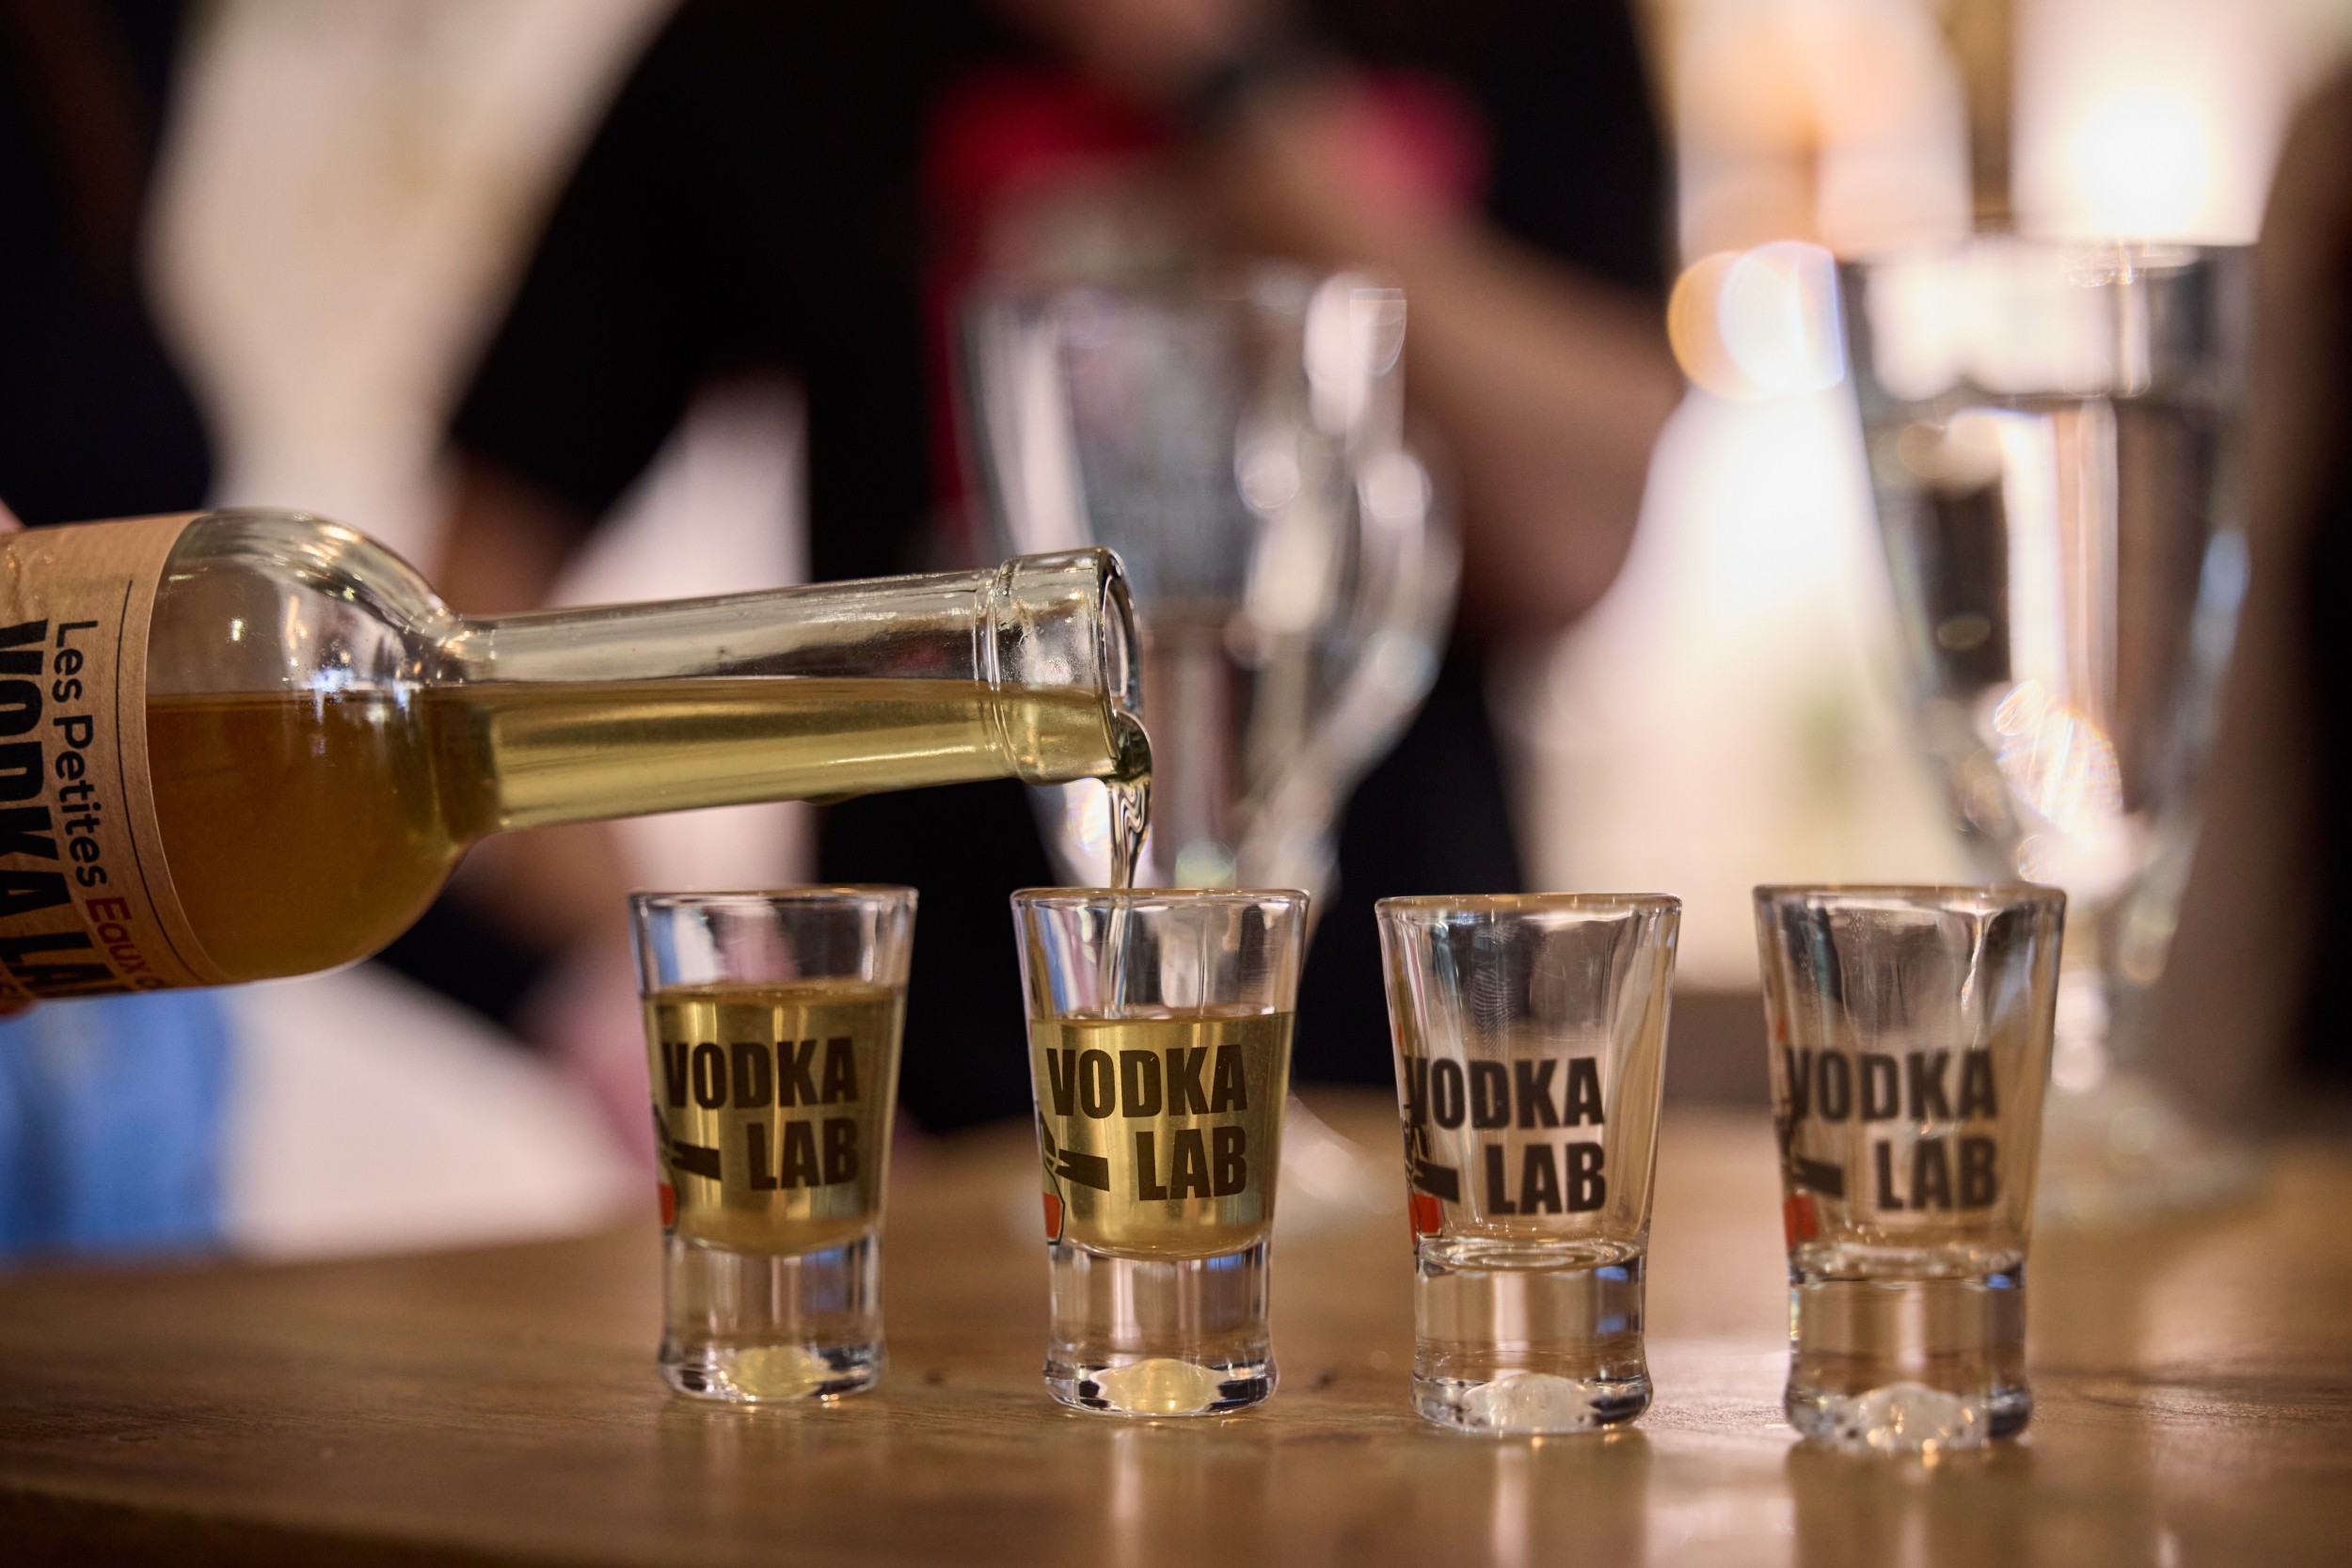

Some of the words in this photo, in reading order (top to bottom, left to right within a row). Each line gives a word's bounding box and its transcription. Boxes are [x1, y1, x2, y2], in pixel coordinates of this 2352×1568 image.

[52, 620, 98, 704] Les
[54, 715, 107, 887] Petites
[86, 897, 151, 974] Eaux
[662, 1037, 859, 1110] VODKA
[1046, 1044, 1248, 1119] VODKA
[1404, 1057, 1604, 1131] VODKA
[1786, 1046, 1996, 1122] VODKA
[747, 1117, 858, 1191] LAB
[1136, 1126, 1248, 1201] LAB
[1486, 1142, 1606, 1215] LAB
[1875, 1135, 1996, 1211] LAB
